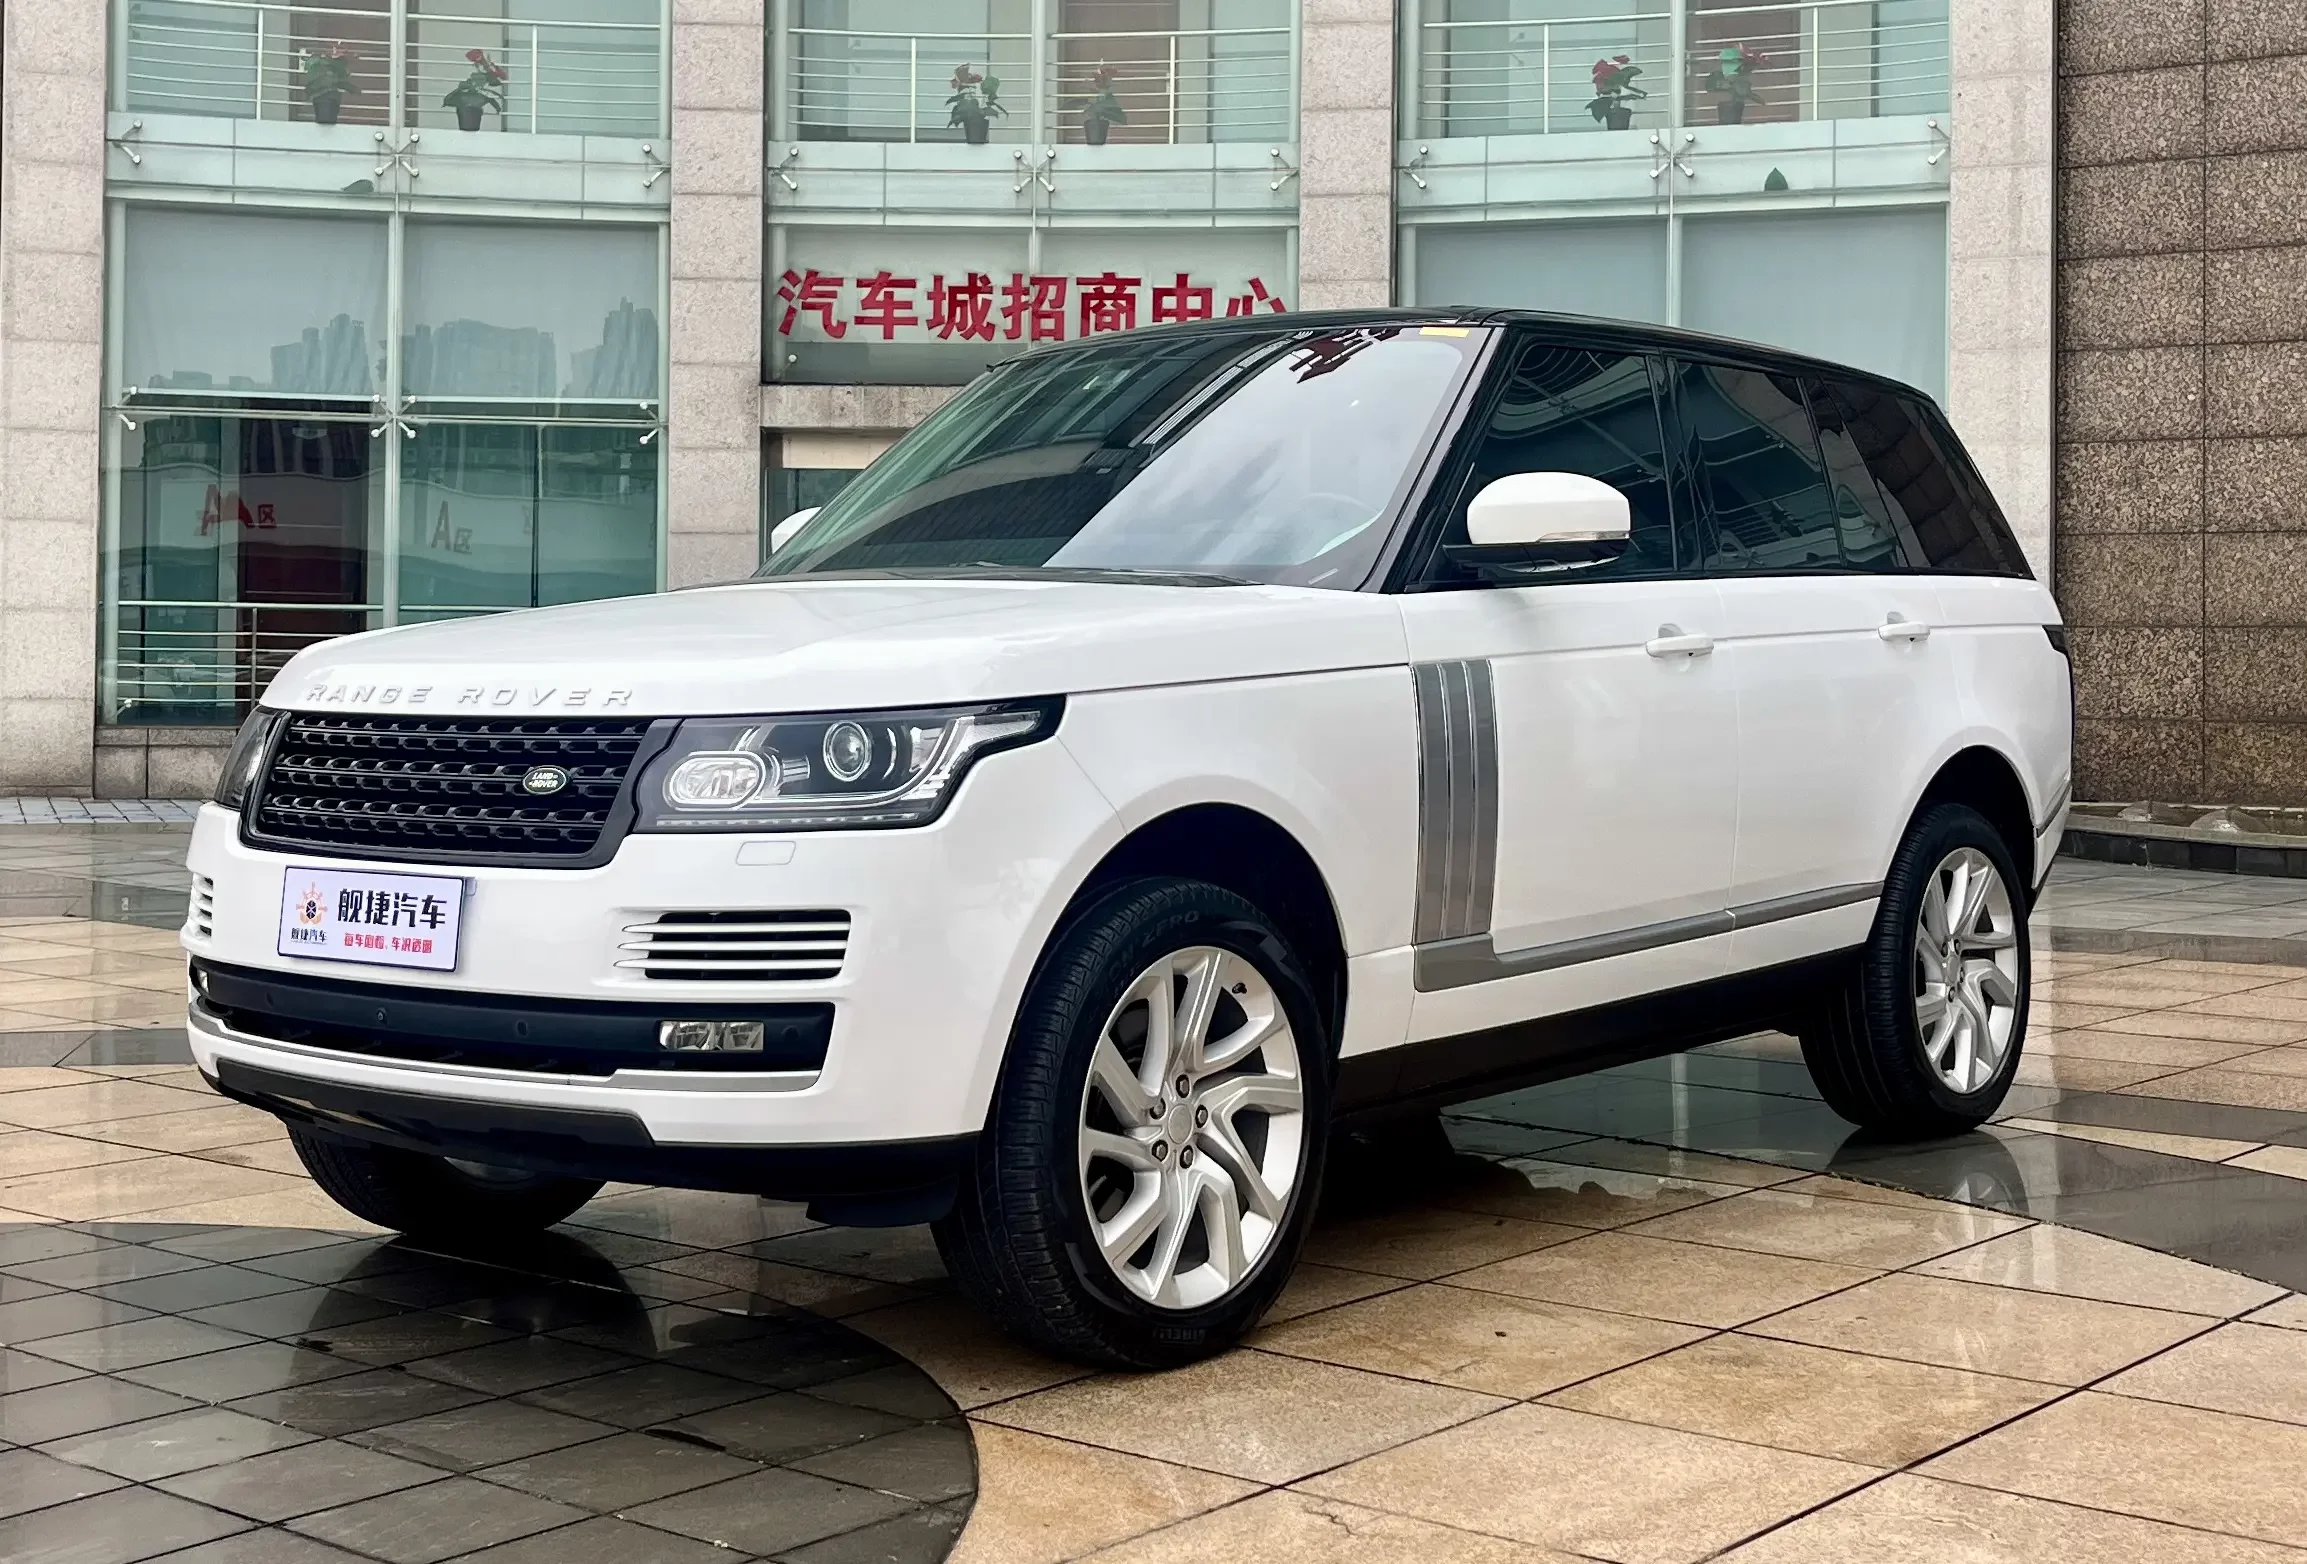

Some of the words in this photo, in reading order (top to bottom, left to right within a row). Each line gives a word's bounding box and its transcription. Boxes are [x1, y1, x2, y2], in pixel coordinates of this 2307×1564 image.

[776, 269, 1288, 342] 汽车城招商中心
[306, 684, 433, 705] RANGE
[457, 686, 634, 707] ROVER
[337, 888, 447, 929] 舰捷汽车
